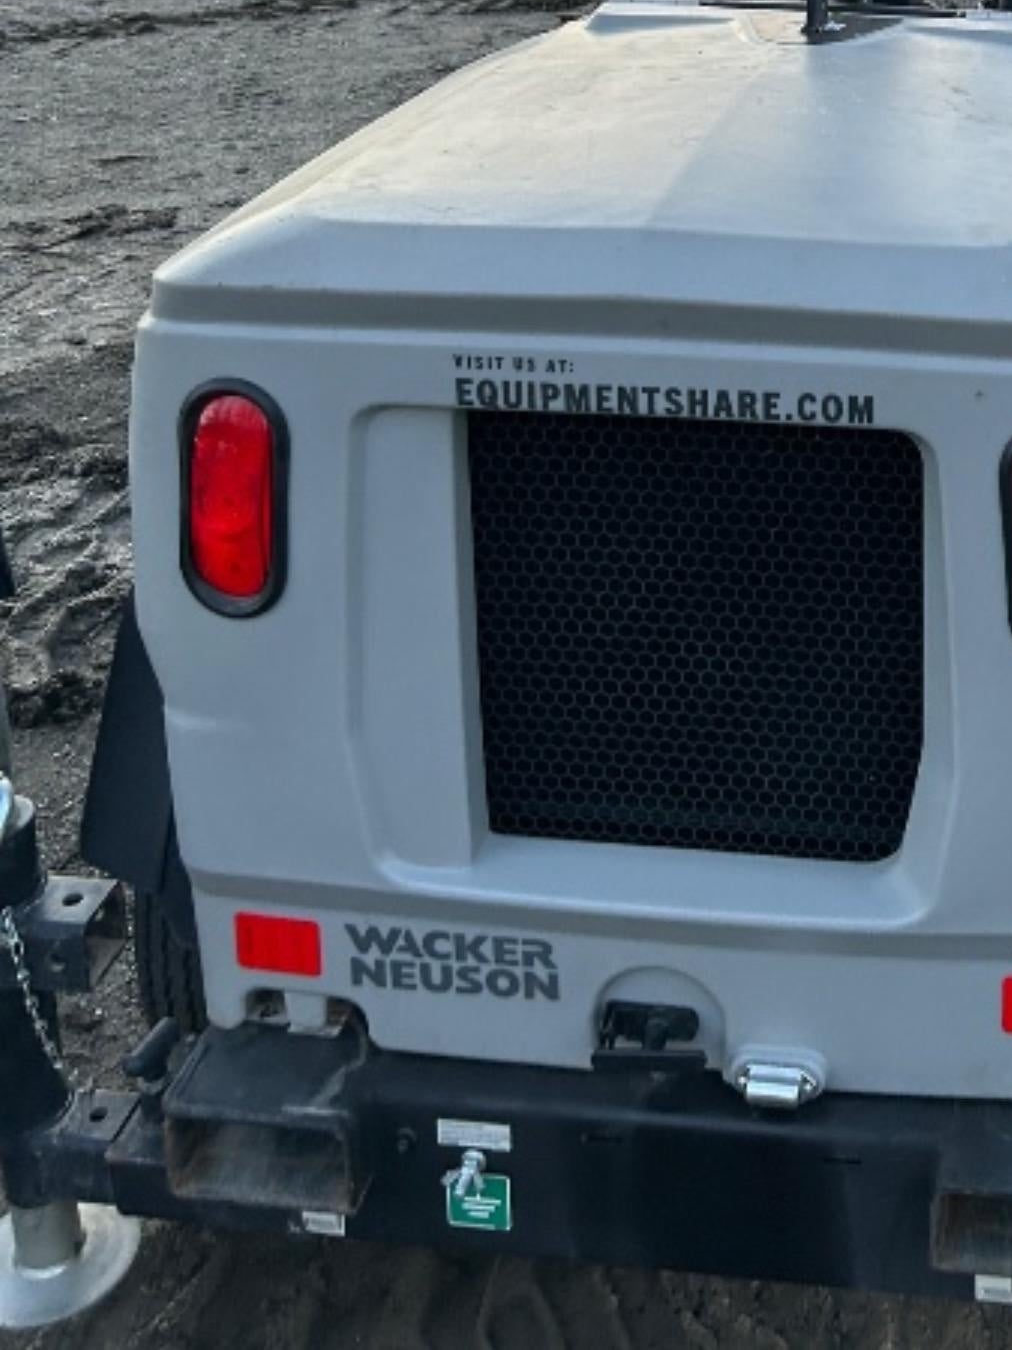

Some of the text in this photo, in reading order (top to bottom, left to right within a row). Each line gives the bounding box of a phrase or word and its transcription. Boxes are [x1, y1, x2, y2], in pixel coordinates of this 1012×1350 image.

[453, 353, 575, 373] VISIT US AT:
[454, 377, 875, 424] EQUIPMENTSHARE.COM
[344, 922, 559, 970] WACKER
[350, 955, 561, 1002] NEUSON
